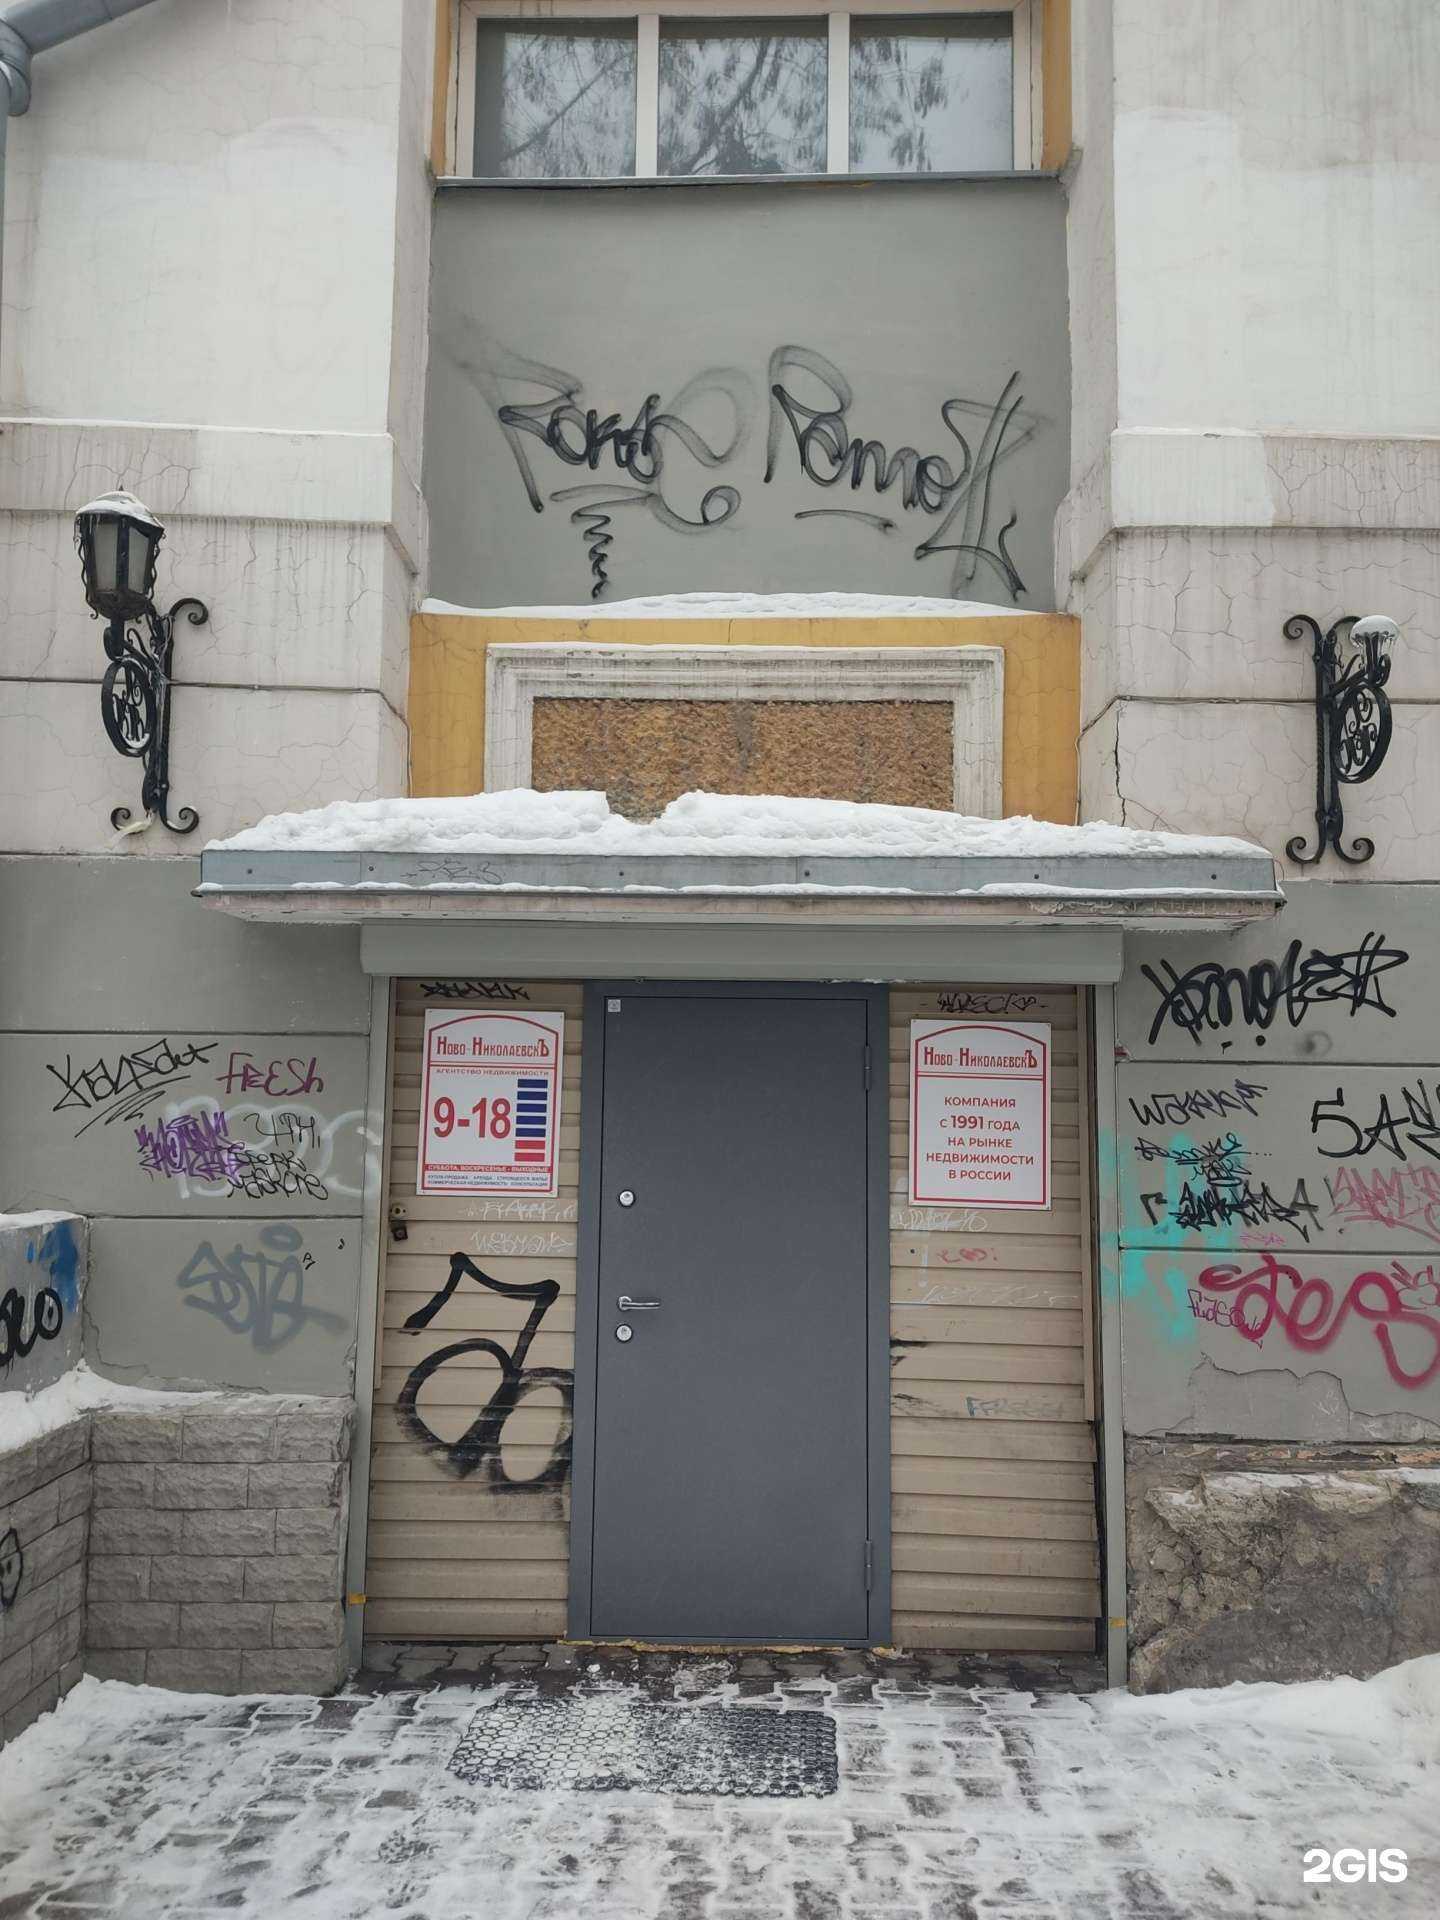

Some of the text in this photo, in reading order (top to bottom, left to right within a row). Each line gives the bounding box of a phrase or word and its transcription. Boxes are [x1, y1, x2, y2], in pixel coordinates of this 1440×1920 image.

[944, 1097, 1016, 1108] КОМПАНИЯ
[434, 1096, 511, 1139] 9-18
[950, 1115, 984, 1130] 1991
[987, 1120, 1021, 1131] ГОДА
[948, 1137, 1013, 1148] НА РЫНКЕ
[926, 1153, 1034, 1165] НЕДВИЖИМОСТИ
[949, 1169, 1011, 1180] В РОССИИ
